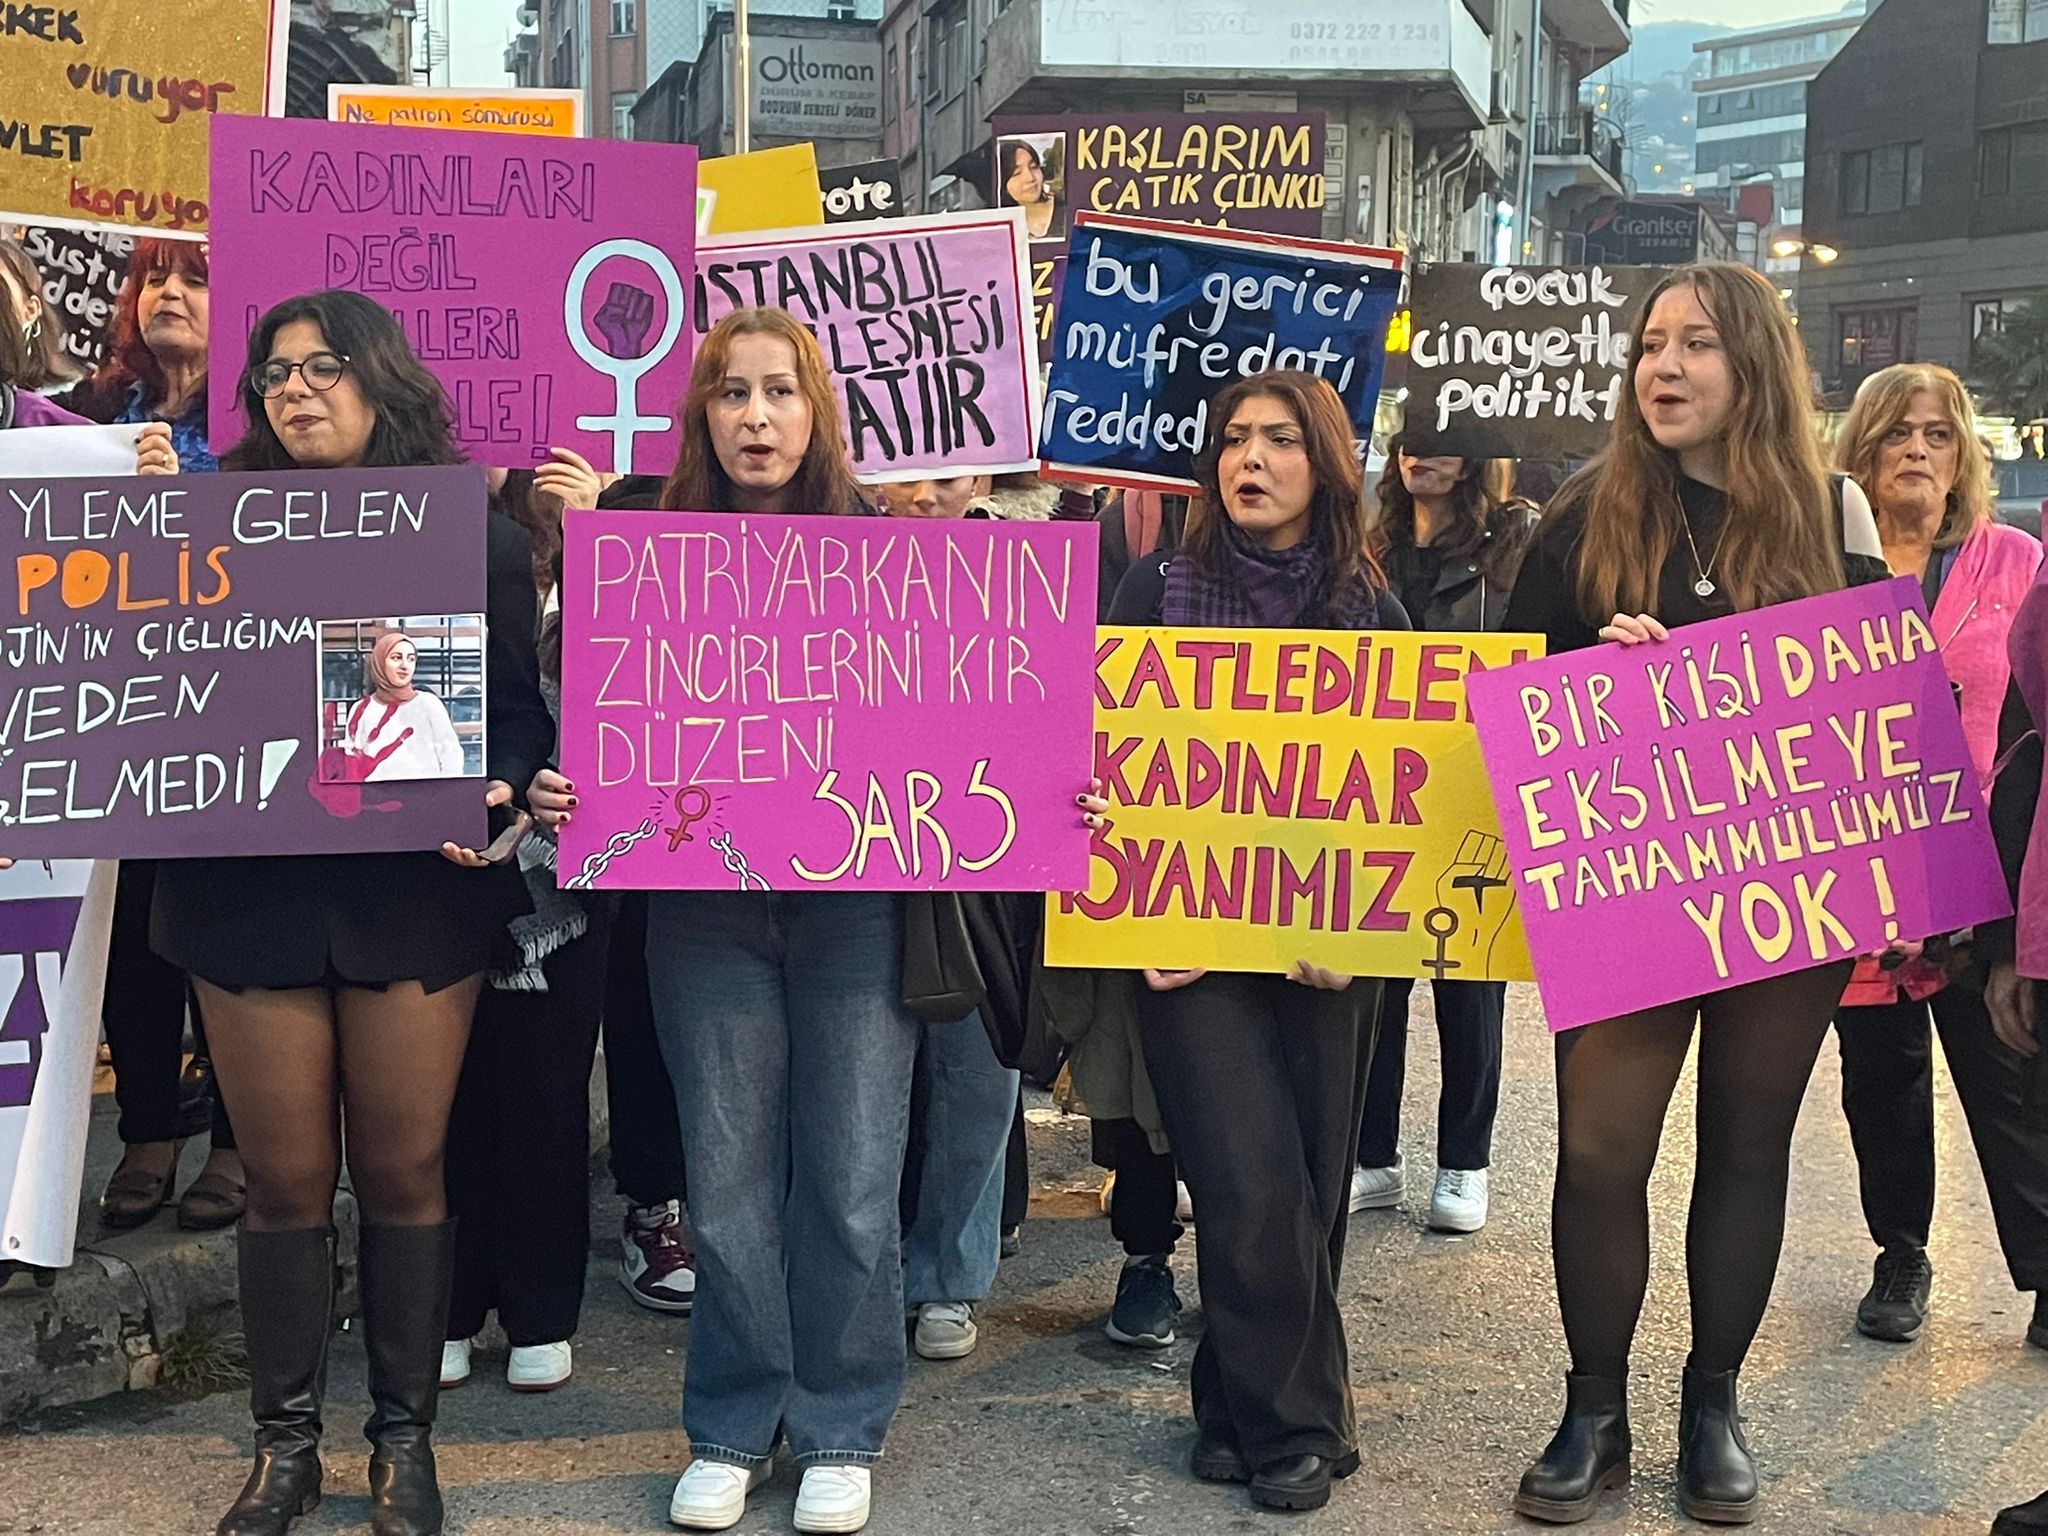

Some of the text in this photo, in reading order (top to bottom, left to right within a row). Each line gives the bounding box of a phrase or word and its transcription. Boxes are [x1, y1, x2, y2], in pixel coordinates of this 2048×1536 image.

[759, 45, 874, 84] Ottoman
[1076, 124, 1311, 172] KAŞLARIM
[249, 149, 594, 222] KADINLARI
[325, 227, 477, 293] DEĞİL
[1085, 237, 1159, 304] bu
[1189, 268, 1370, 338] gerici
[1066, 322, 1355, 394] müfredatı
[1042, 389, 1214, 454] redded
[9, 487, 430, 544] YLEME GELEN
[16, 541, 232, 615] POLİS
[593, 520, 1072, 629] PATRİYARKANIN
[0, 612, 316, 668] JİN'İN ÇIĞLIĞINA
[590, 618, 1046, 707] ZİNCİRLERİNİ KIR
[1519, 673, 1623, 757] BİR
[1775, 609, 1936, 700] DAHA
[597, 707, 834, 787] DÜZENİ
[1094, 731, 1430, 825] KADINLAR
[789, 758, 1018, 882] SARS
[1523, 771, 1972, 913] TAHAMMÜLÜMÜZ
